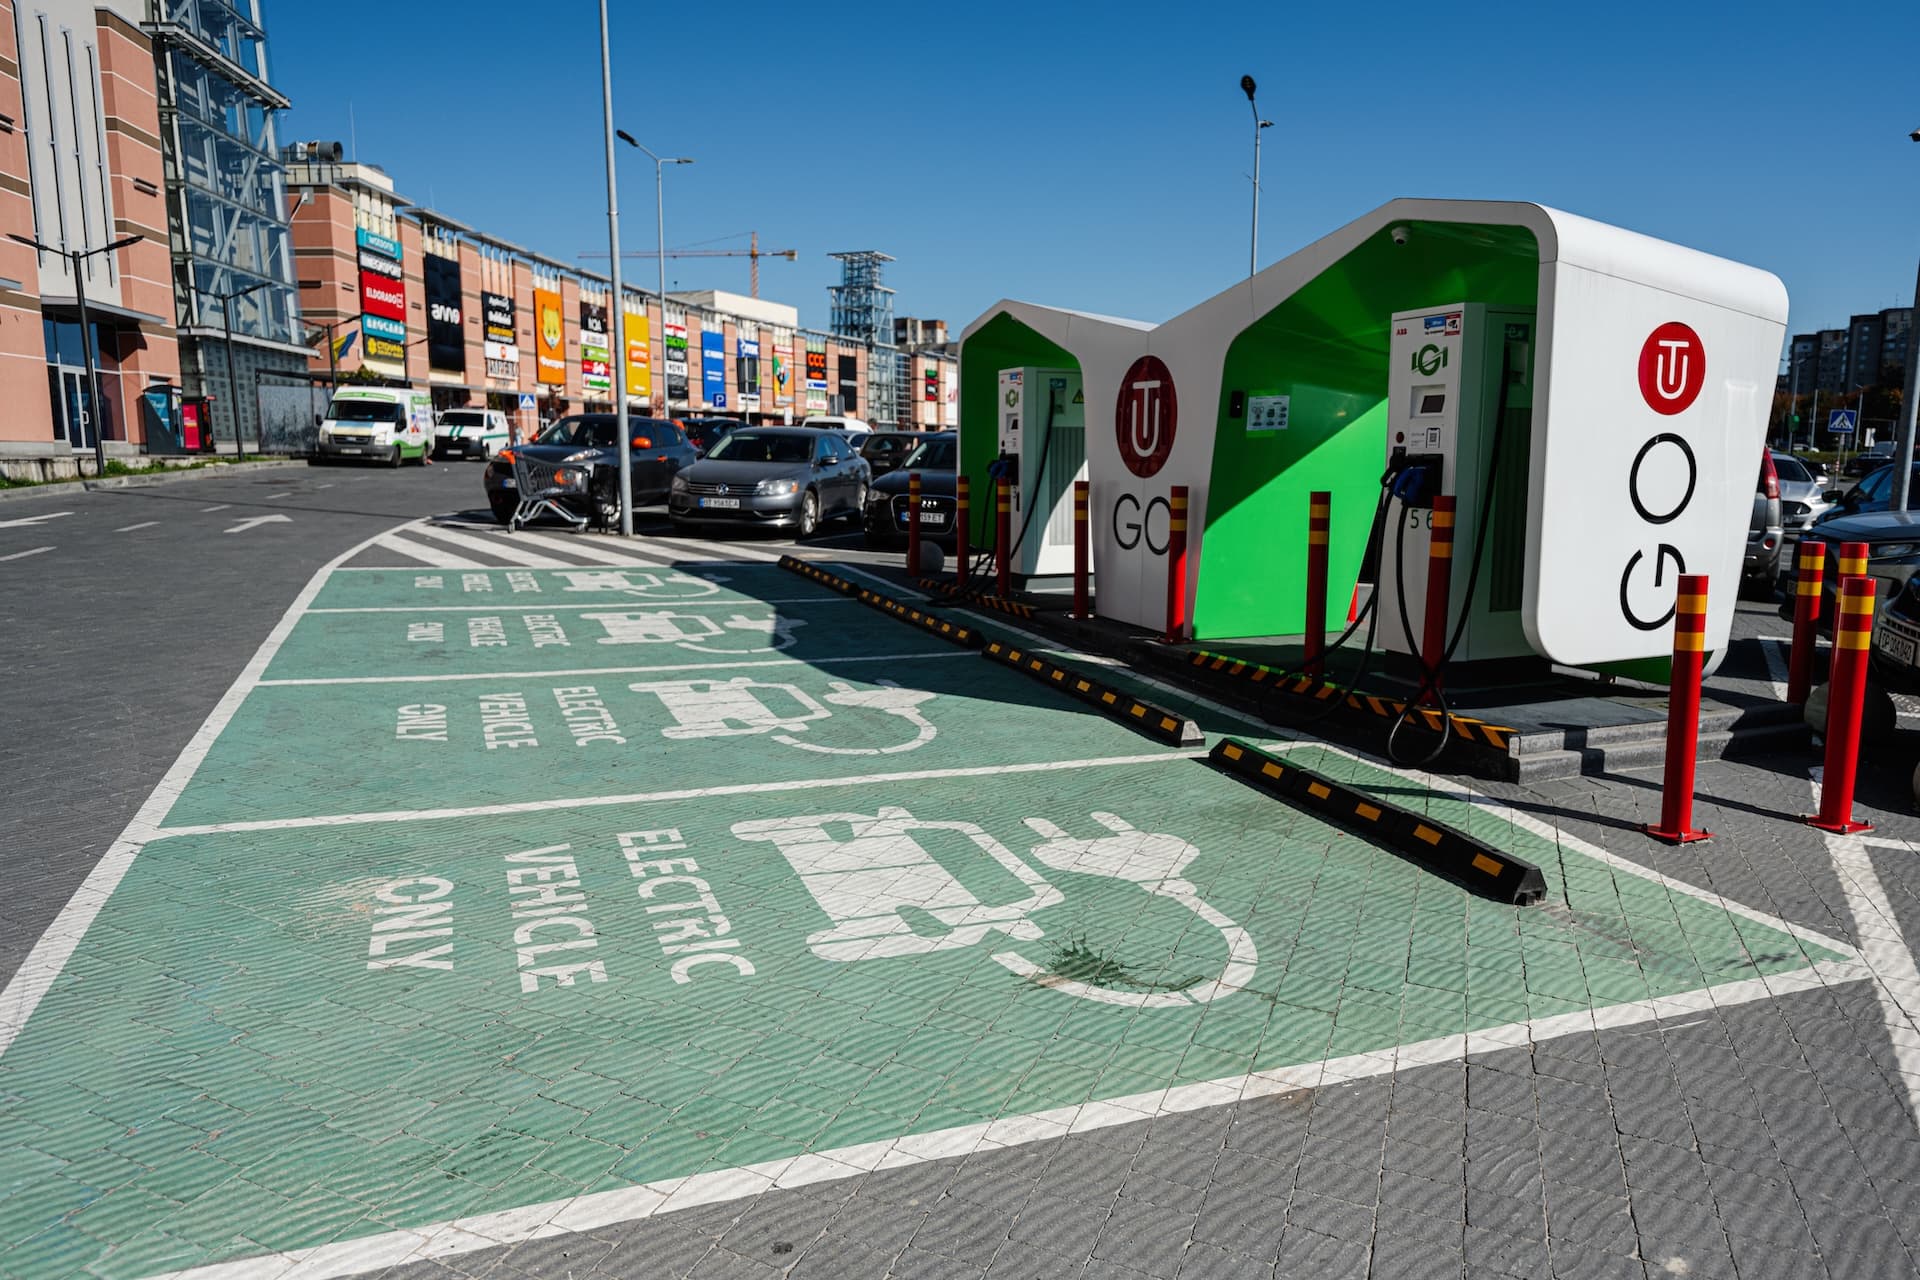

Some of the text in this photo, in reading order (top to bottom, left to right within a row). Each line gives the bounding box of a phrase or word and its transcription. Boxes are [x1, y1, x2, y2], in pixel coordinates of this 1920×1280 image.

[808, 353, 824, 368] CCC
[715, 394, 725, 406] P
[1112, 493, 1172, 555] GO
[1410, 509, 1420, 529] 5
[1620, 432, 1697, 631] GO
[468, 616, 508, 647] VEHICLE
[522, 614, 571, 648] ELECTRIC
[396, 704, 448, 741] ONLY
[479, 692, 539, 750] VEHICLE
[552, 686, 627, 747] ELECTRIC
[366, 875, 454, 970] ONLY
[504, 843, 608, 993] VEHICLE
[616, 828, 756, 985] ELECTRIC
